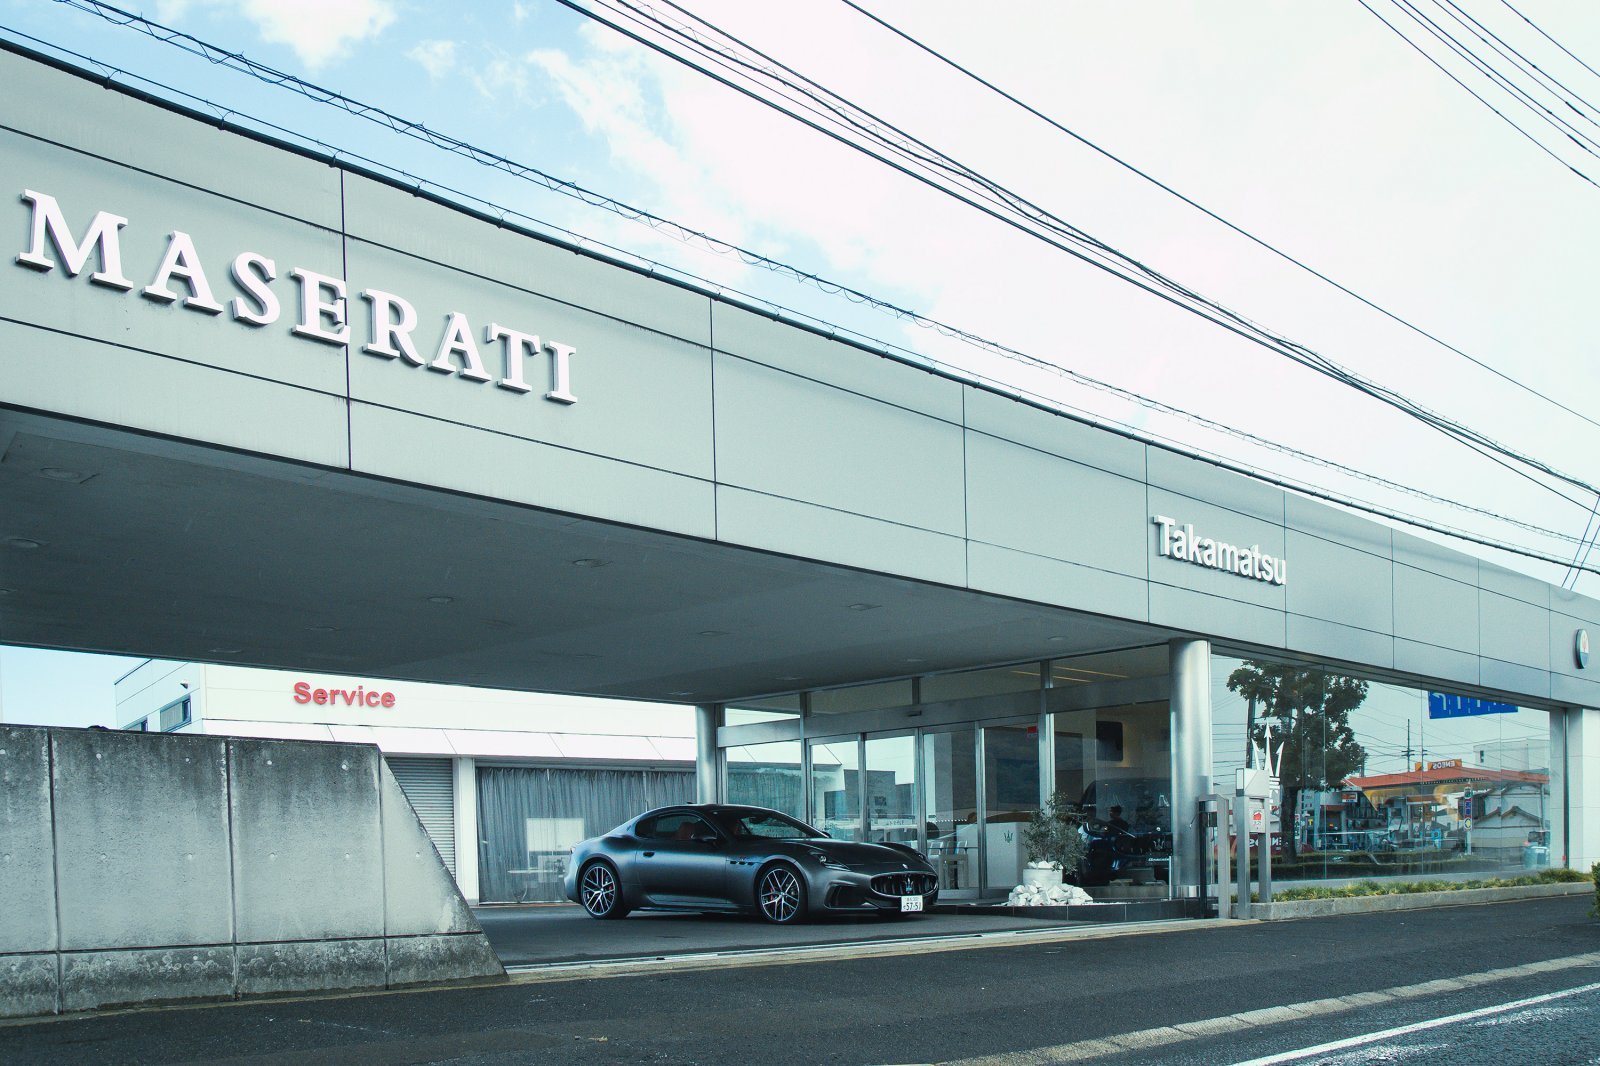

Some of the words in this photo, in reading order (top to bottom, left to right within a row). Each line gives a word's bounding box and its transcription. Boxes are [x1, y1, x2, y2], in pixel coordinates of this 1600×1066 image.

[15, 188, 578, 403] MASERATI
[1153, 515, 1287, 585] Takamatsu
[293, 682, 396, 708] Service
